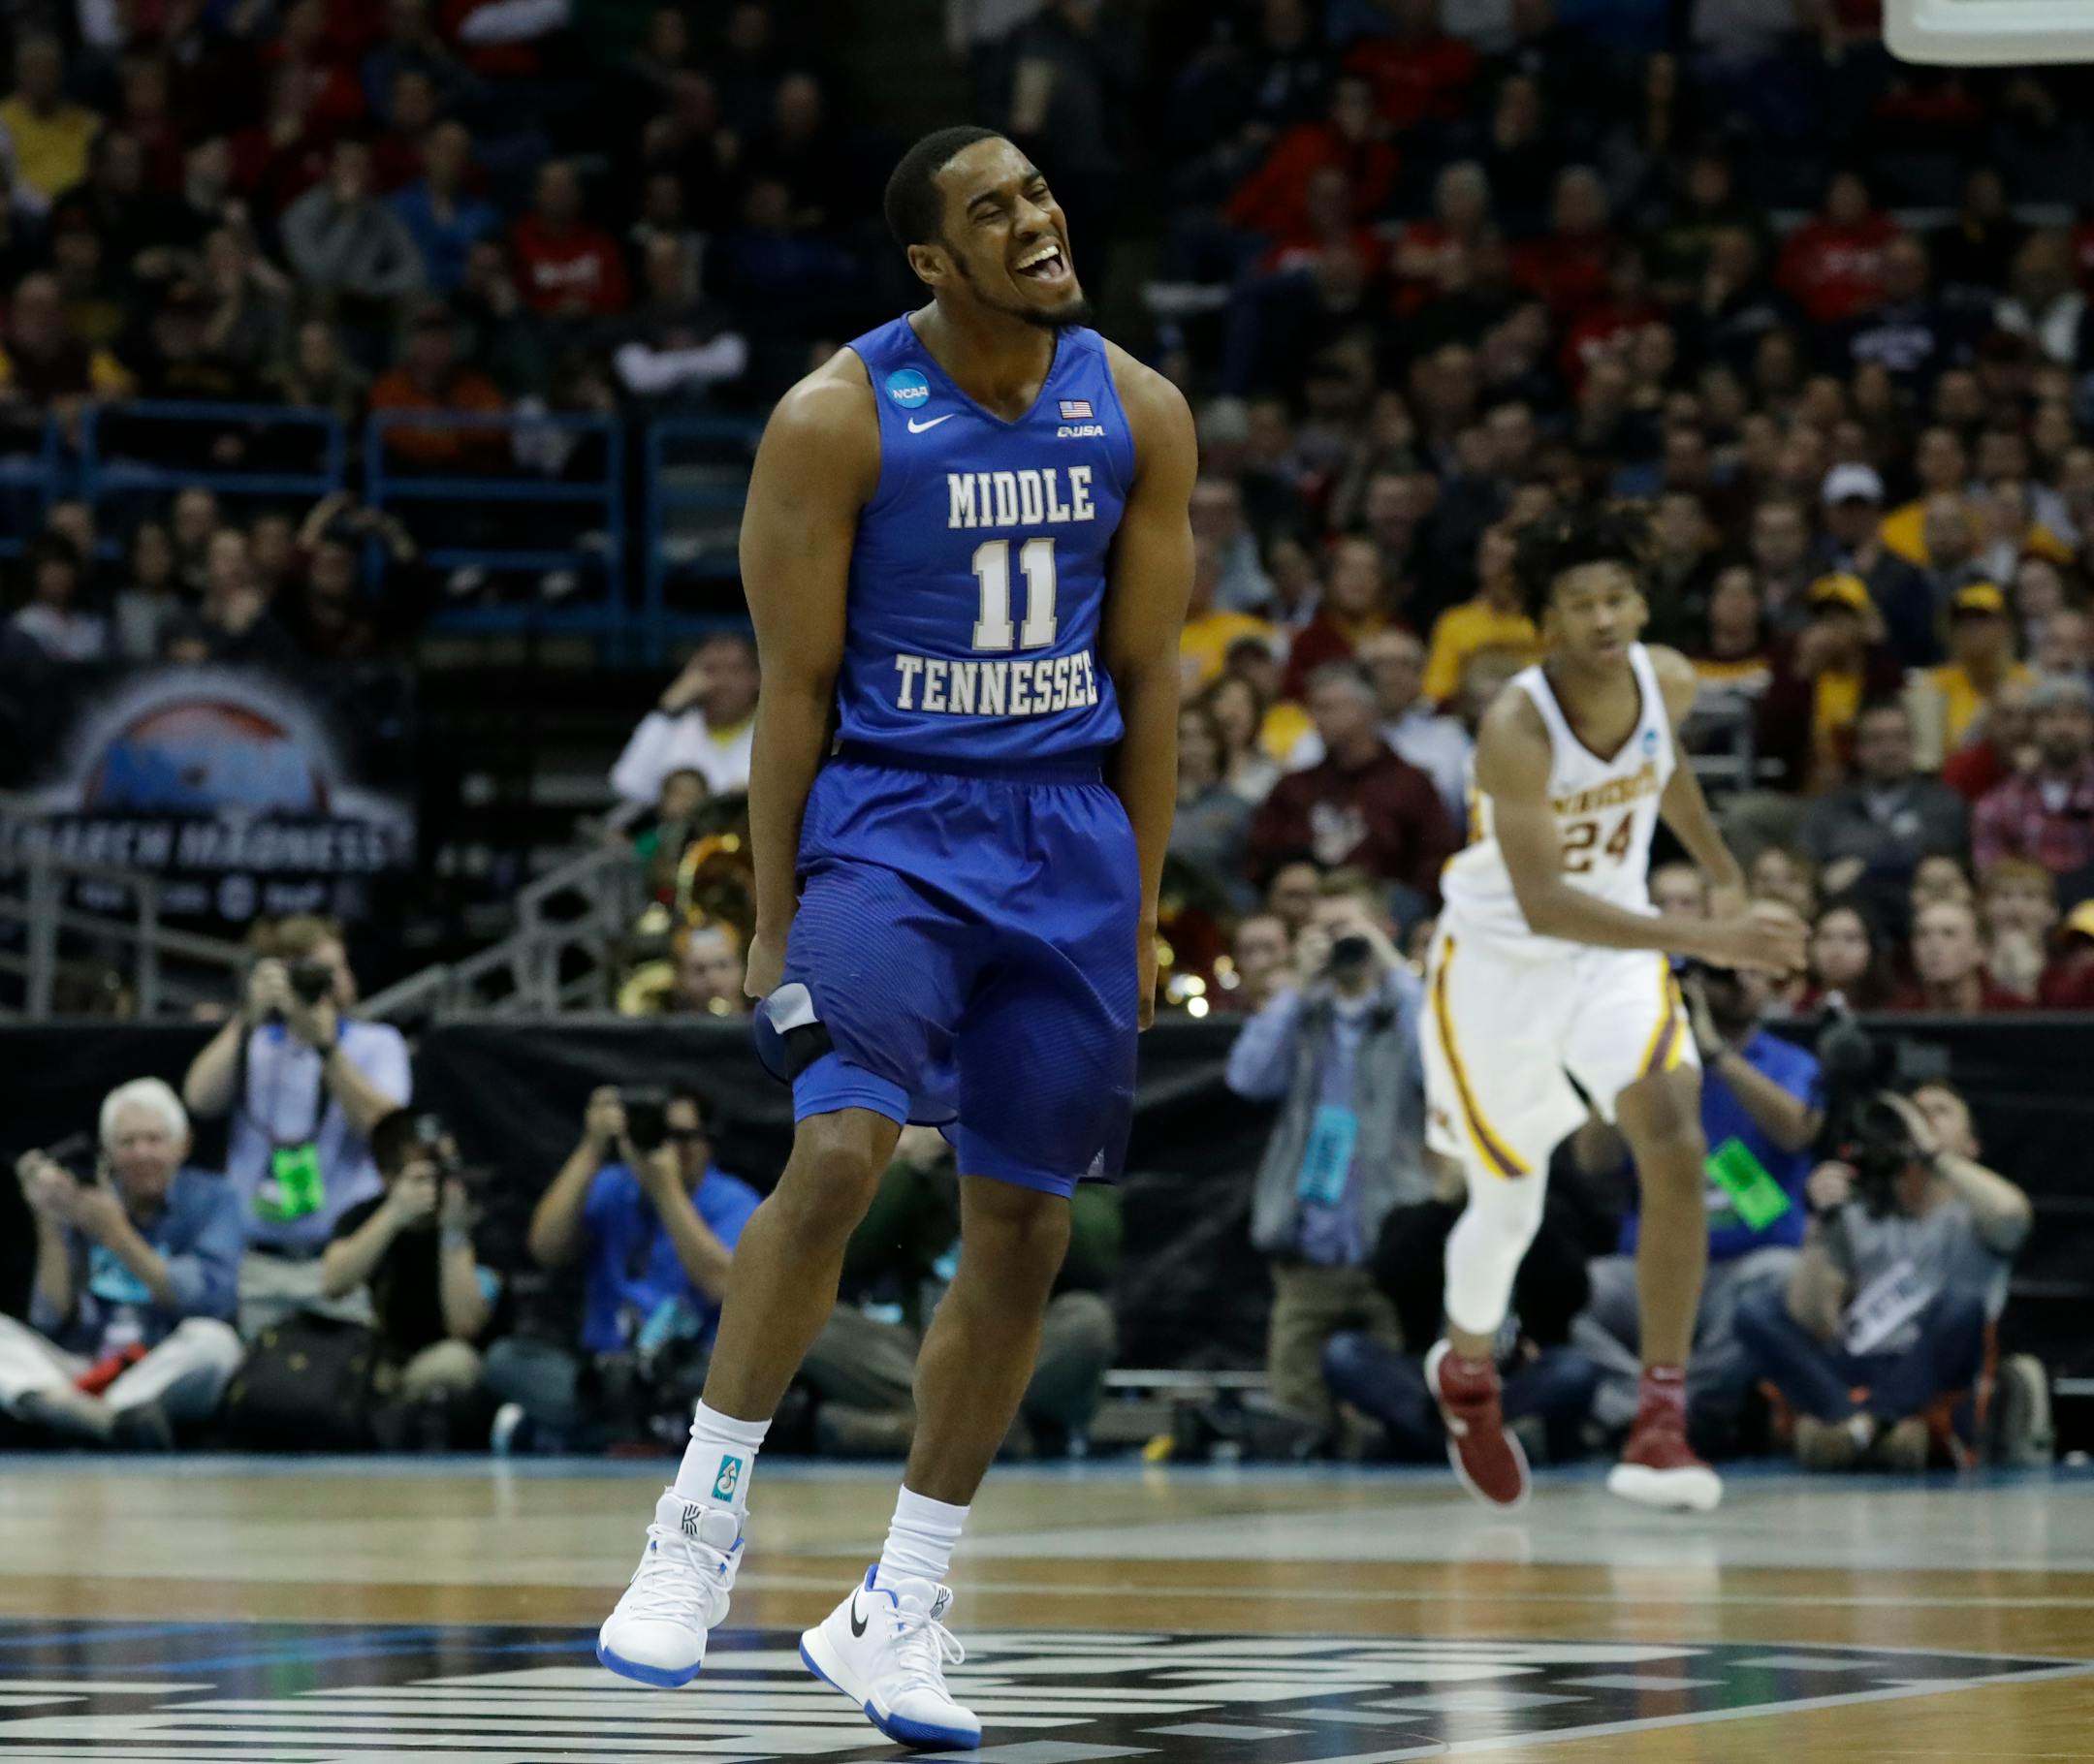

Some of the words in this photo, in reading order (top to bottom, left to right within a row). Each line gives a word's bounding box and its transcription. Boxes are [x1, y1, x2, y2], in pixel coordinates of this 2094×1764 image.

[893, 386, 929, 399] NCAA
[947, 465, 1095, 528] MIDDLE
[971, 537, 1059, 651] 11
[895, 649, 1098, 716] TENNESSEE
[1561, 811, 1634, 873] 24
